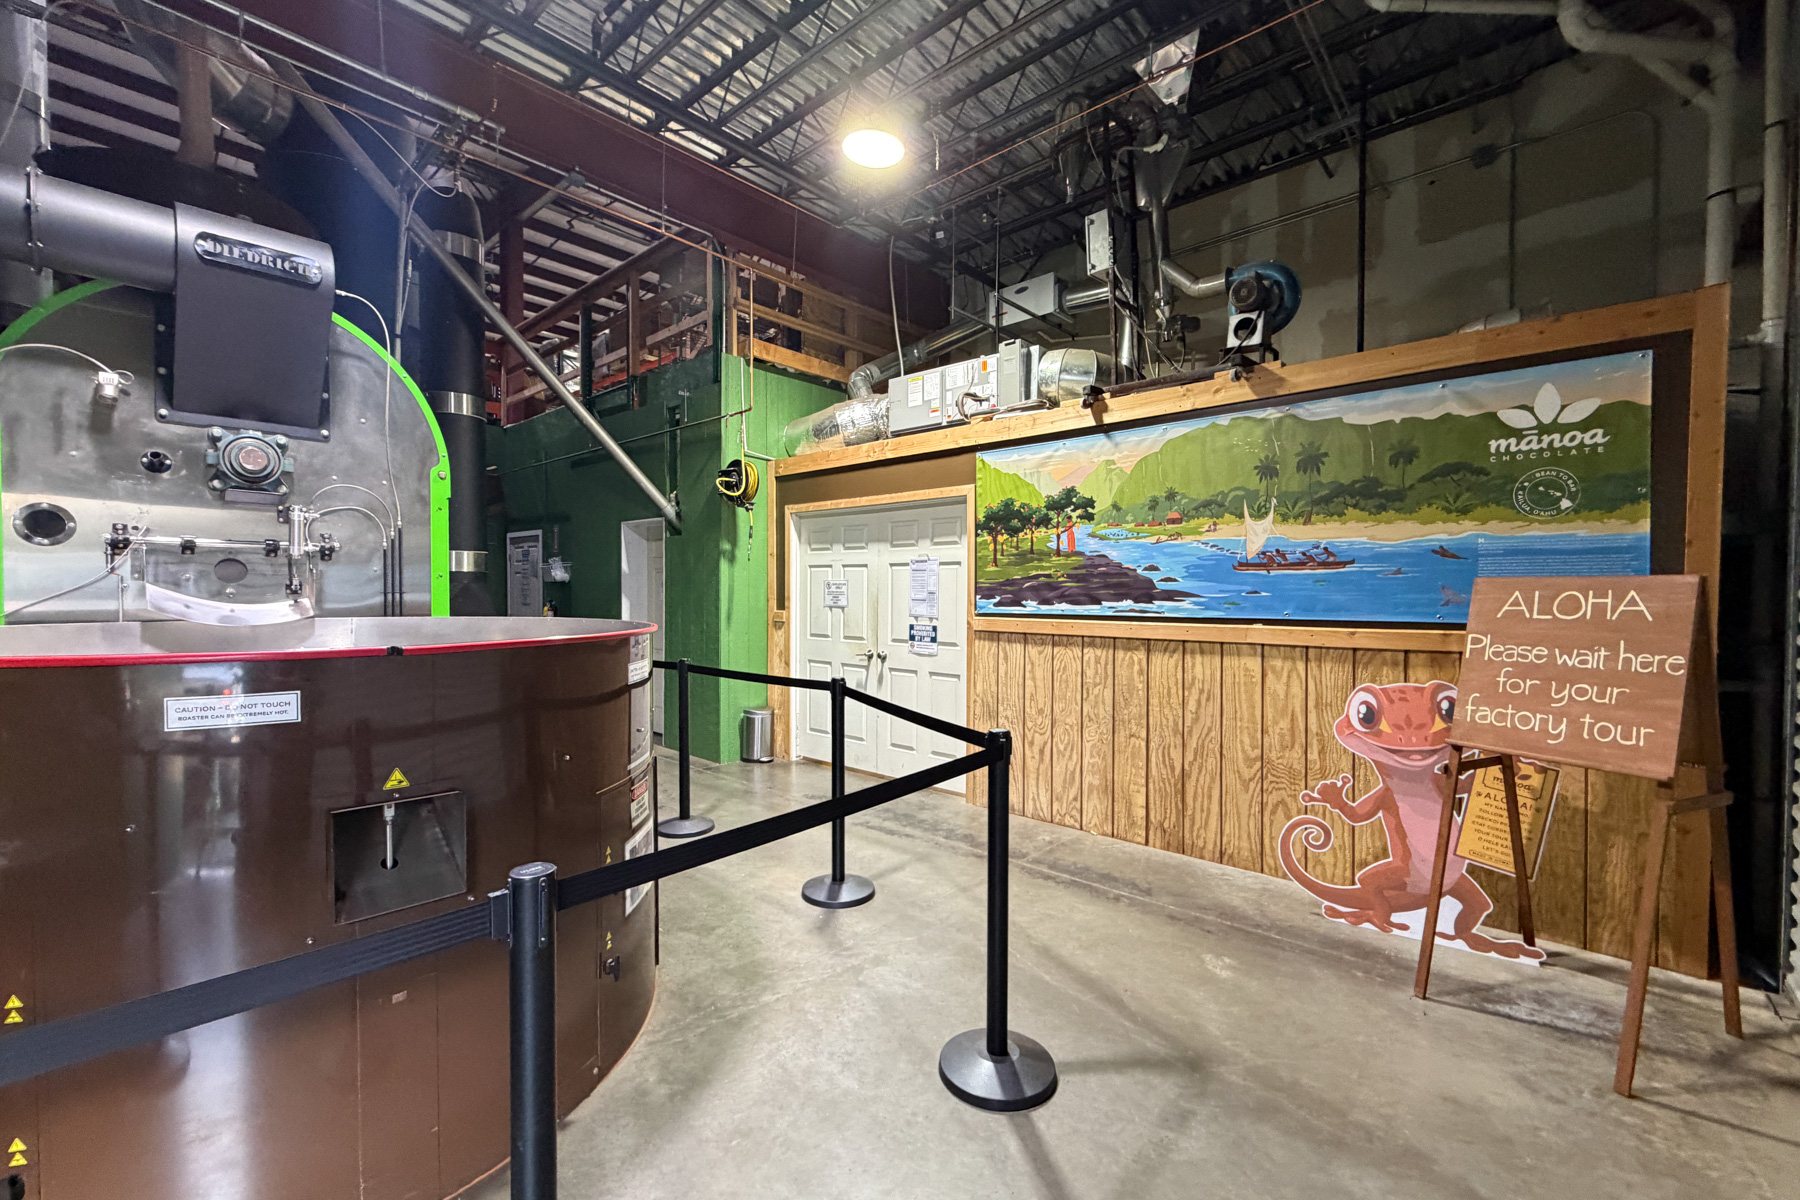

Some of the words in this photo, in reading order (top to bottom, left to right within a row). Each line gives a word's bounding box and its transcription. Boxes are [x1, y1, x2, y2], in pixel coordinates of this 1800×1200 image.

[205, 239, 312, 276] DIEDRICH
[1488, 428, 1612, 454] mānoa
[1490, 446, 1604, 463] CHOCOLATE
[1559, 472, 1568, 480] TO
[1567, 479, 1577, 492] BAR
[1496, 589, 1654, 621] ALOHA
[1465, 633, 1549, 664] Please
[1555, 646, 1611, 671] wait
[1618, 640, 1687, 676] here
[1496, 667, 1541, 696] for
[1551, 680, 1631, 707] your
[174, 705, 216, 714] CAUTION
[1465, 693, 1567, 744] factory
[1579, 713, 1656, 747] tour
